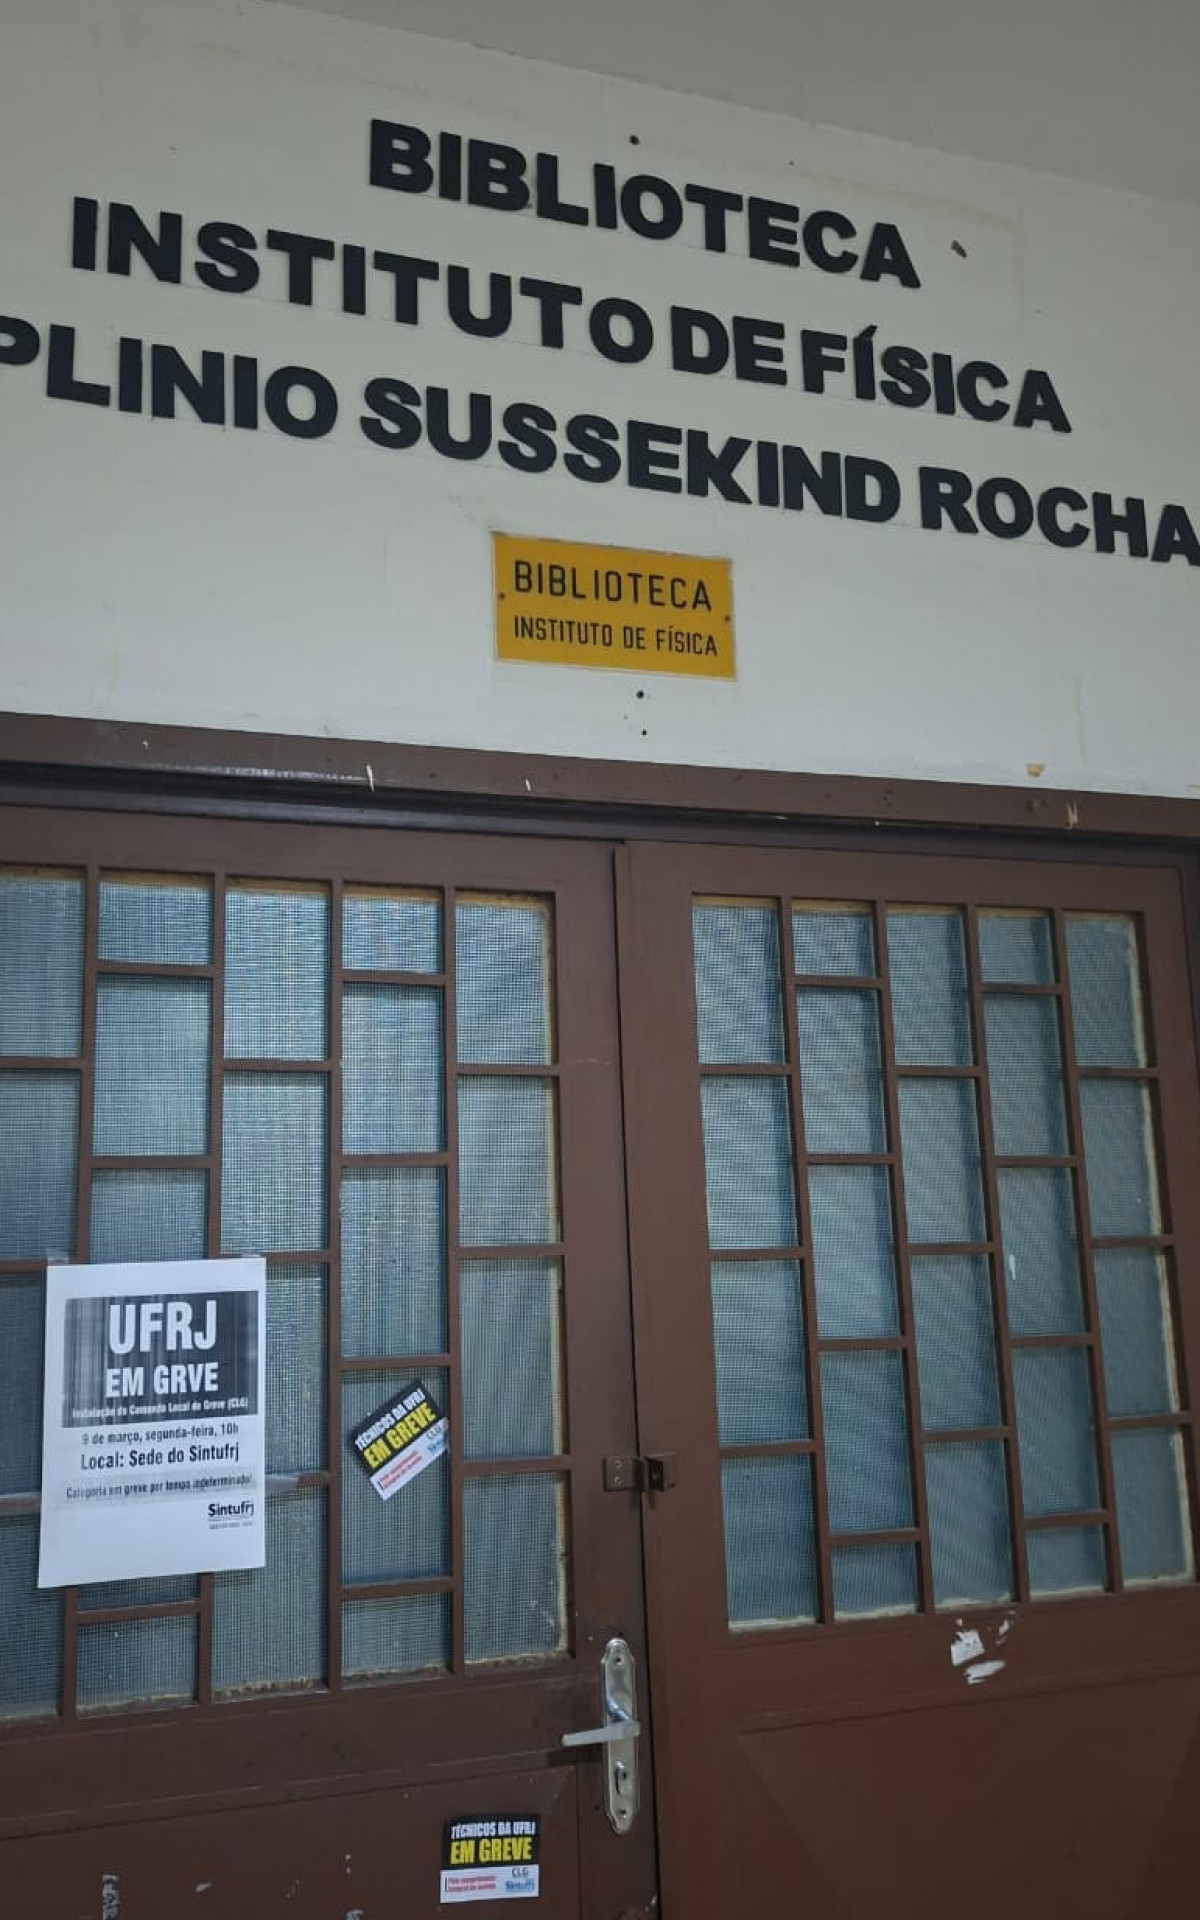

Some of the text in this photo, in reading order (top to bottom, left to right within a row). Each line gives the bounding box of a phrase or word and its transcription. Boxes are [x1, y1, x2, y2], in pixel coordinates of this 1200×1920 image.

[369, 118, 921, 289] BIBLIOTECA
[71, 196, 1072, 434] INSTITUTO DE FÍSICA
[360, 377, 901, 524] SUSSEKIND
[919, 466, 1200, 567] ROCHA
[514, 559, 712, 612] BIBLIOTECA
[514, 615, 718, 657] INSTITUTO DE FÍSICA
[109, 1300, 217, 1355] UFRJ
[105, 1362, 219, 1398] EM GRVE
[92, 1431, 104, 1444] de
[145, 1424, 217, 1442] segunda-feira,
[221, 1421, 239, 1436] 10h
[363, 1402, 437, 1469] EM GREVE
[80, 1442, 239, 1470] Local: Sede do Sintufrj
[208, 1500, 255, 1517] Sintufrj
[498, 1821, 511, 1836] DA
[513, 1821, 536, 1835] UFRJ
[450, 1837, 532, 1865] EM GREVE
